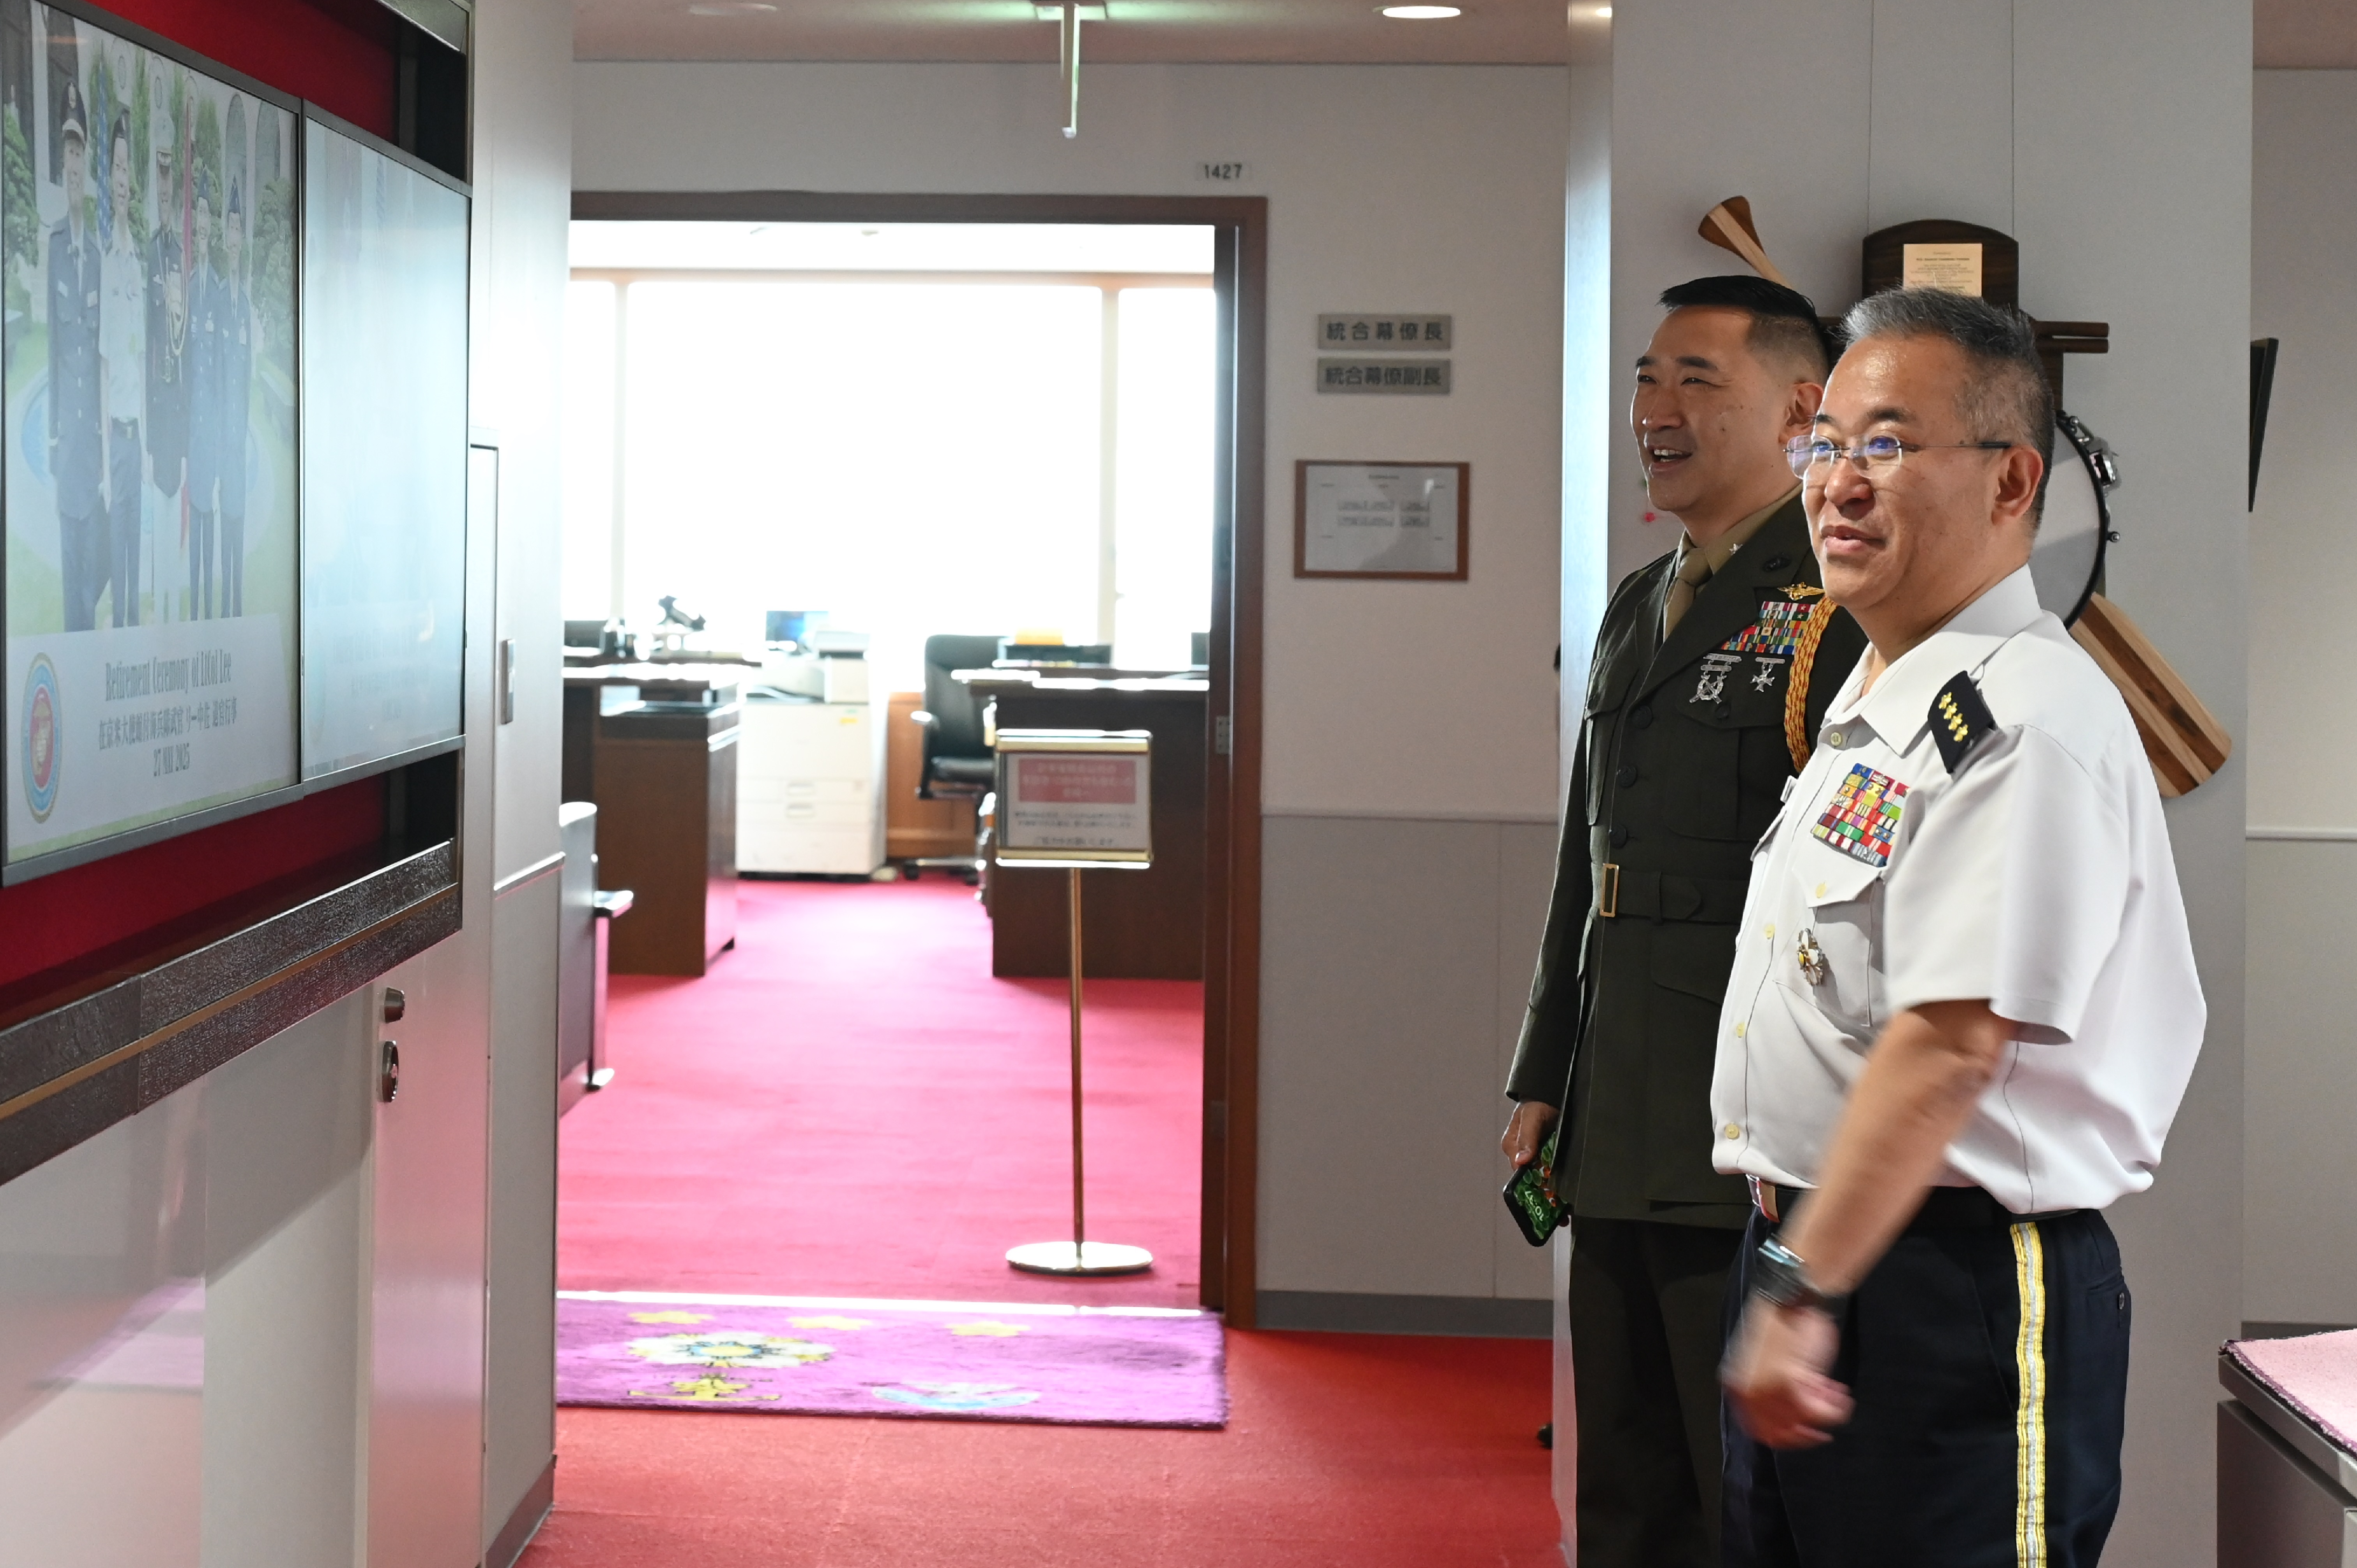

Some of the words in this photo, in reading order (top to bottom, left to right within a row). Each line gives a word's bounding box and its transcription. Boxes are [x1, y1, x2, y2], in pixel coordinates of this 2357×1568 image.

[1204, 164, 1242, 179] 1427
[1326, 321, 1444, 341] 統合幕僚長
[1325, 366, 1442, 386] 統合幕僚副長
[105, 661, 150, 701] Retirement
[152, 656, 189, 694] Ceremony
[191, 652, 199, 687] of
[219, 649, 231, 684] Lee
[153, 748, 161, 777] 27
[175, 743, 190, 771] 2025
